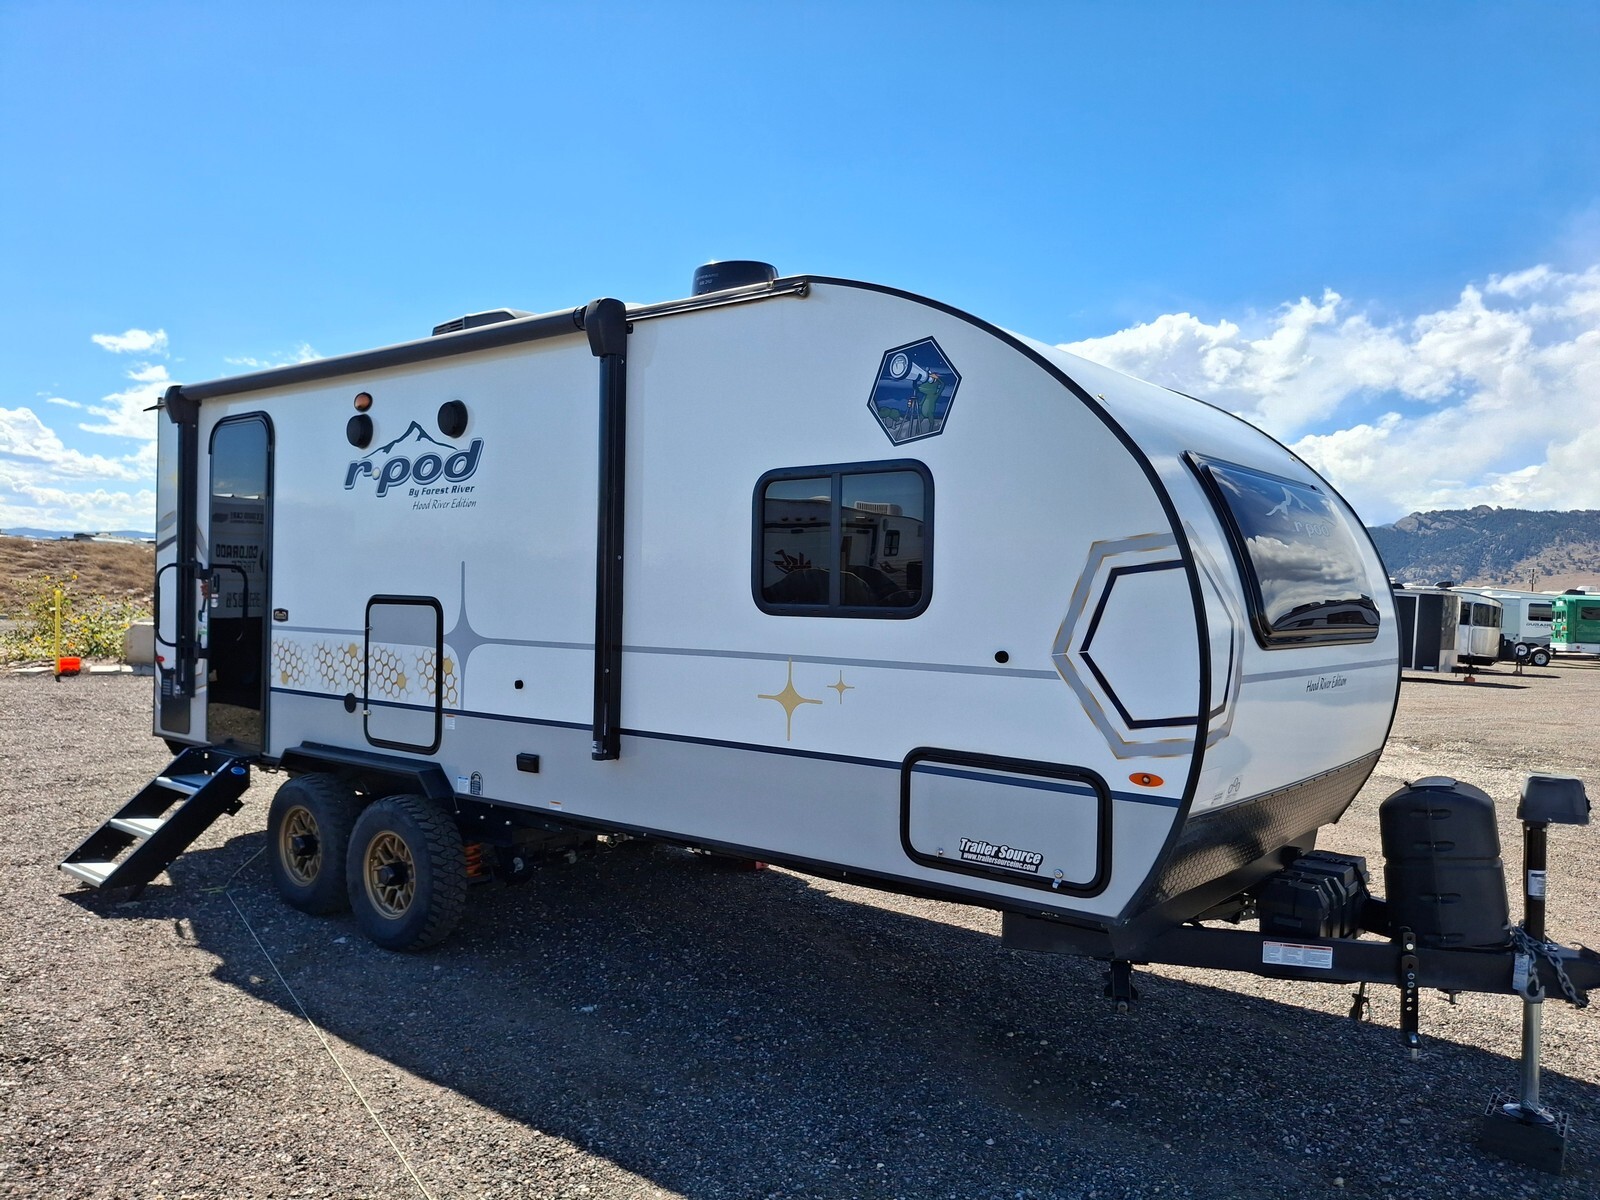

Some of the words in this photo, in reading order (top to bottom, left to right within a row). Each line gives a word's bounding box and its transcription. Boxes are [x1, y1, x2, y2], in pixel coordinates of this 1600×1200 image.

[408, 488, 420, 498] By
[421, 486, 449, 496] Forest
[451, 484, 476, 494] River
[412, 499, 432, 511] Hood
[431, 499, 450, 509] River
[451, 497, 477, 509] Edition
[1305, 676, 1320, 693] Hood
[1319, 677, 1332, 690] River
[1331, 673, 1347, 689] Edition
[960, 838, 999, 857] Trailer
[998, 845, 1042, 865] Source
[962, 852, 1037, 872] www.trailersourceinc.com
